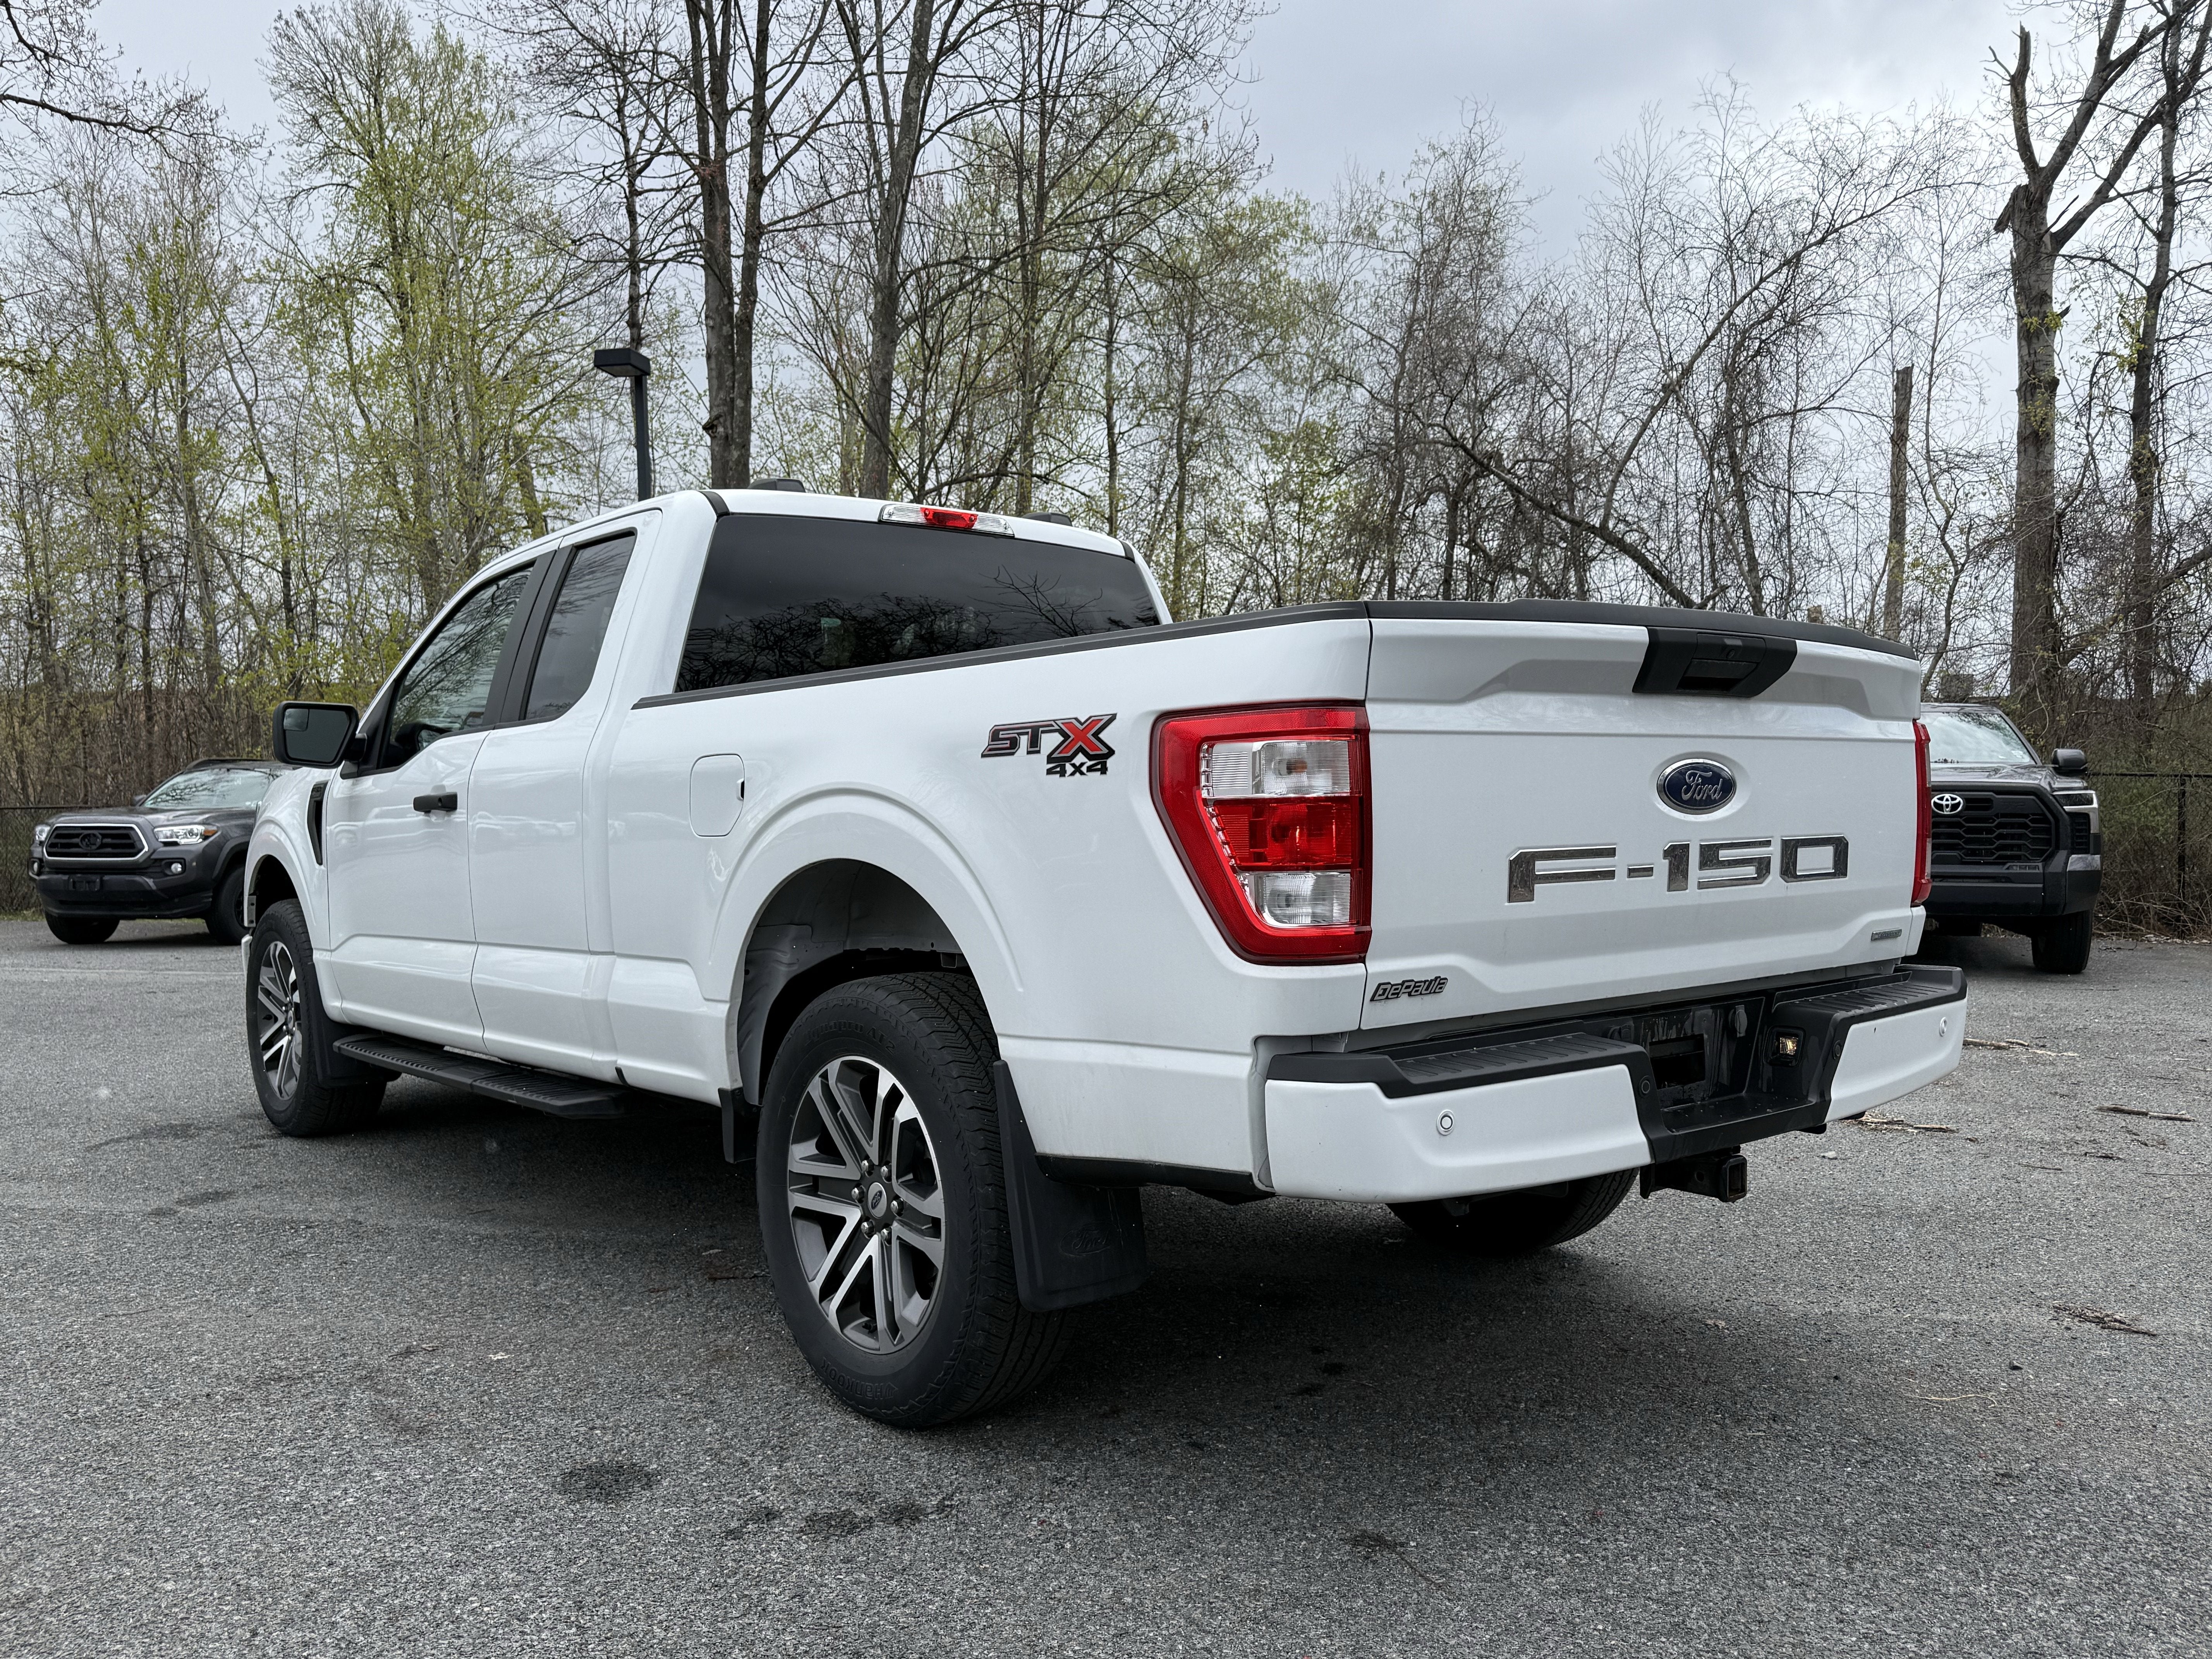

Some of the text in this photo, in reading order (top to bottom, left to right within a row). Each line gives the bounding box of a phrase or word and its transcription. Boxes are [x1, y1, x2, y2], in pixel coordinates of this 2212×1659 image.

[981, 713, 1117, 764] STX
[1681, 770, 1723, 801] Ford
[1508, 835, 1849, 903] F-150
[1370, 976, 1448, 1001] DePaula
